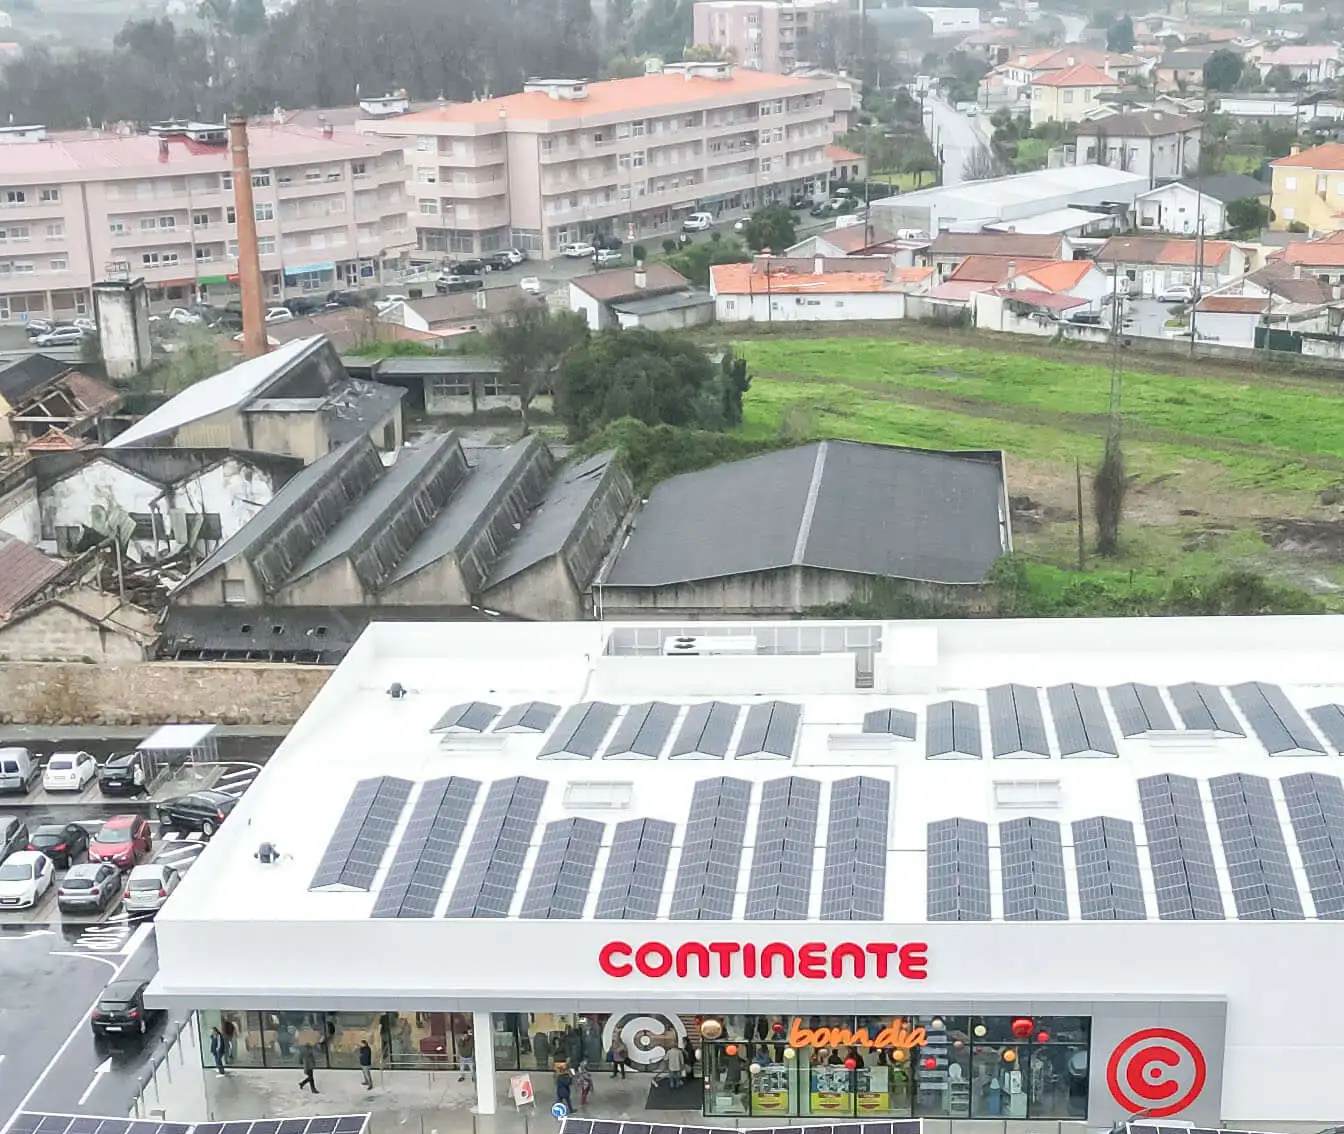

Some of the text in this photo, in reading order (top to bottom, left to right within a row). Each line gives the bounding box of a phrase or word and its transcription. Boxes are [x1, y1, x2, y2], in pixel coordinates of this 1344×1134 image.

[598, 940, 928, 980] CONTINENTE
[789, 1017, 929, 1049] bom dia
